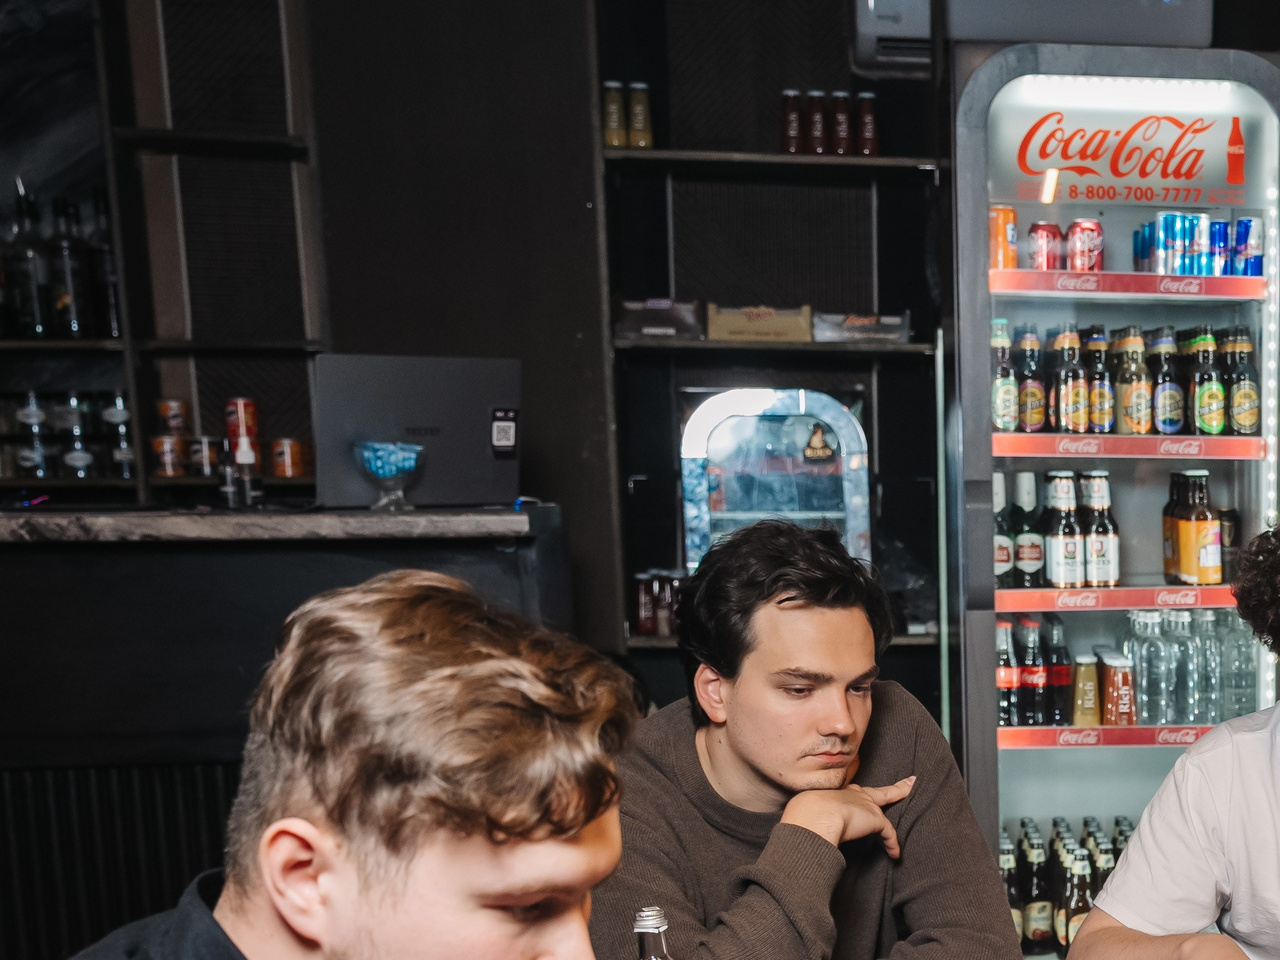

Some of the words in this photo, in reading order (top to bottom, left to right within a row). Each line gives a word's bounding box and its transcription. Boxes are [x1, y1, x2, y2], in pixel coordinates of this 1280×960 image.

[1017, 111, 1219, 180] Coca-Cola
[1068, 184, 1202, 203] 8-800-700-7777
[1119, 685, 1130, 713] Rich
